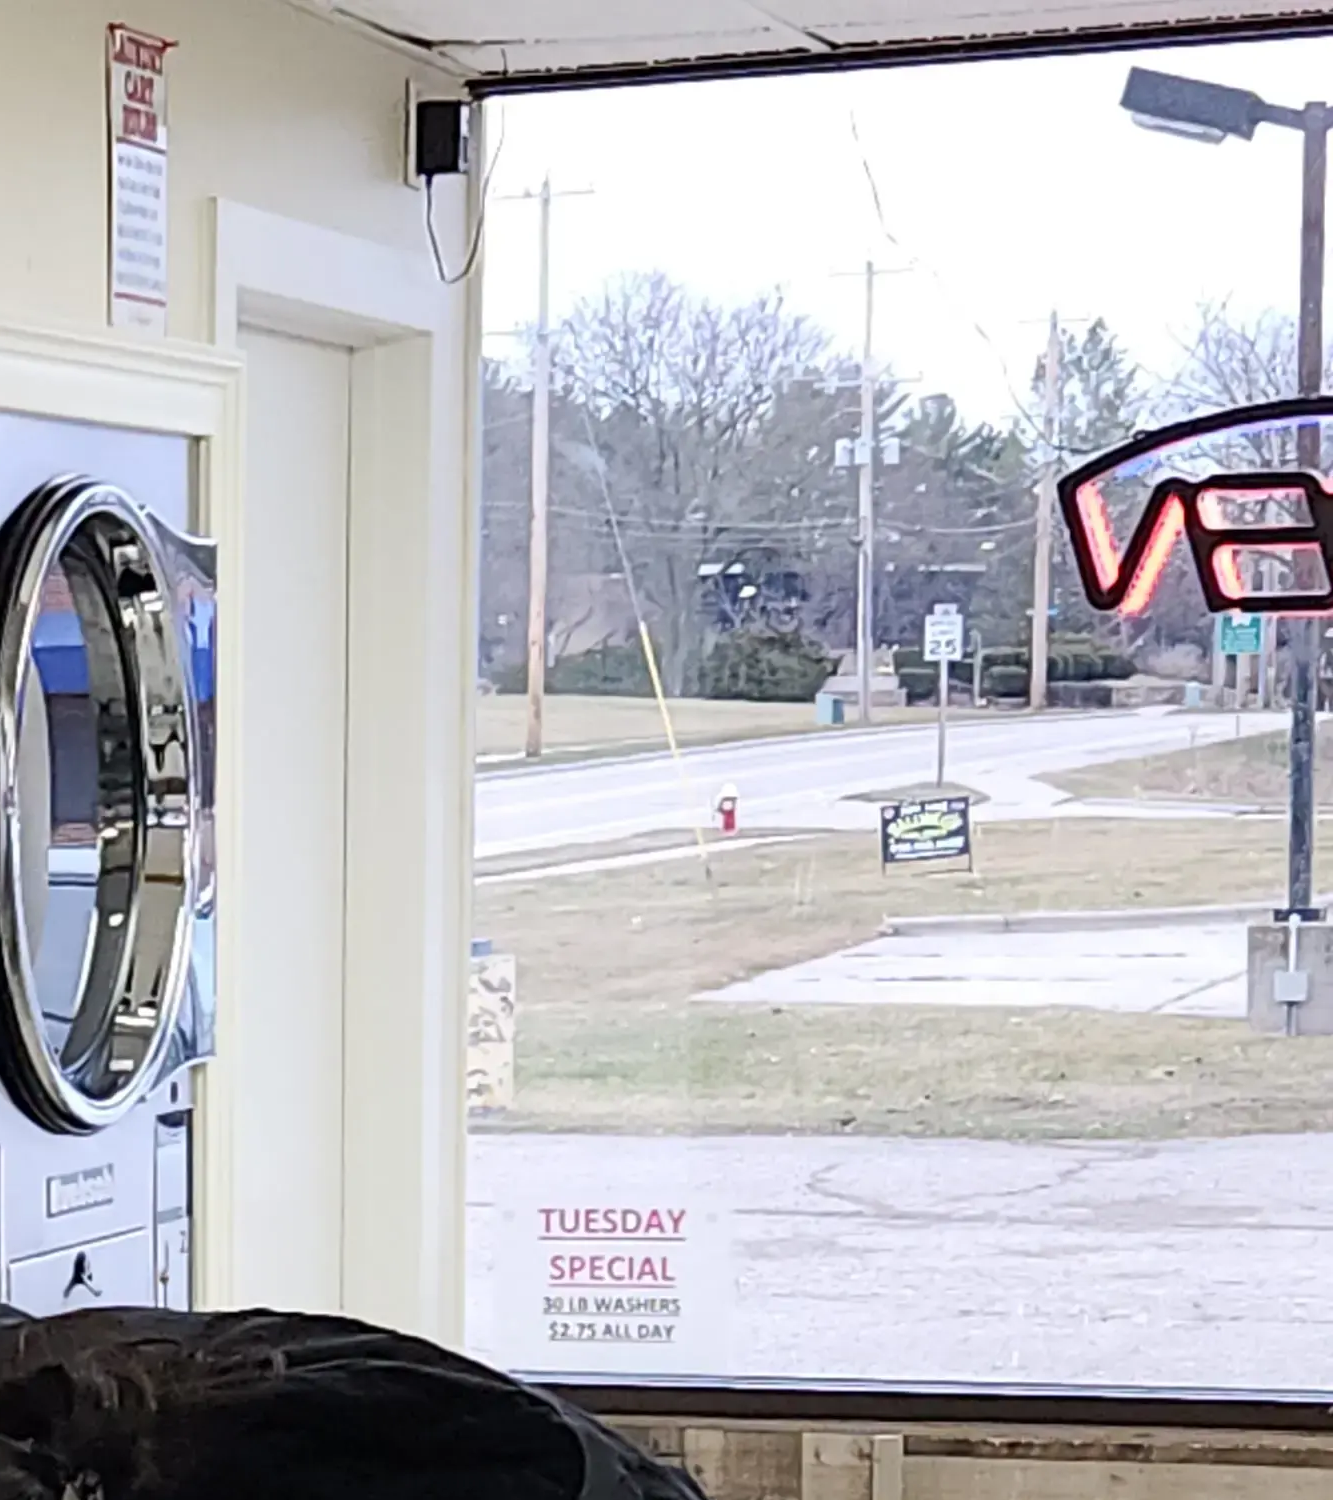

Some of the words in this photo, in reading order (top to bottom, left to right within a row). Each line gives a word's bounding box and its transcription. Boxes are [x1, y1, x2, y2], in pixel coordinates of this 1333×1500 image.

[929, 638, 957, 656] 25
[539, 1208, 686, 1234] TUESDAY
[549, 1255, 676, 1282] SPECIAL
[543, 1296, 564, 1313] 30
[594, 1296, 680, 1313] WASHERS
[549, 1320, 596, 1340] $2.75
[602, 1323, 632, 1339] ALL
[637, 1323, 675, 1340] DAY
